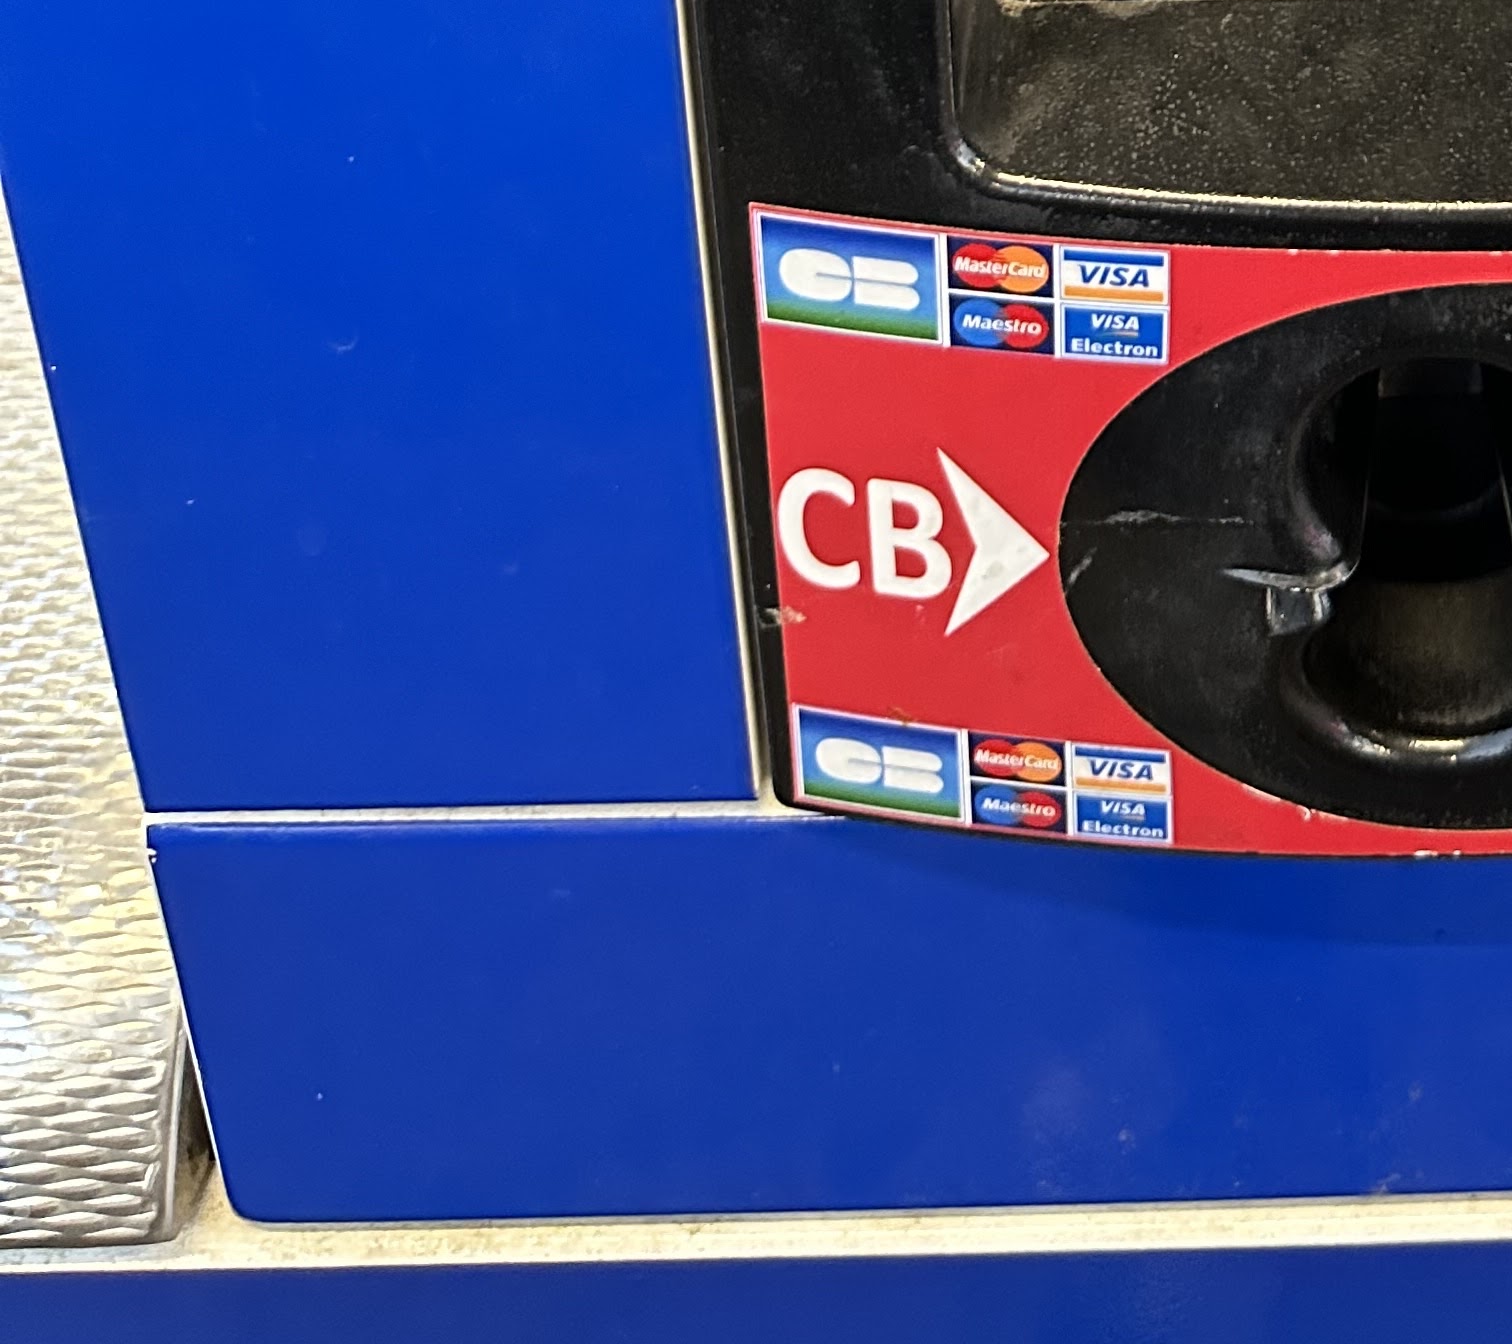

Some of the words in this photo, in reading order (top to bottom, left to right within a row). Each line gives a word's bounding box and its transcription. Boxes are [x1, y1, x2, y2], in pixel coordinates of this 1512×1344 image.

[954, 255, 1046, 280] MasterCard
[1077, 263, 1151, 288] VISA
[961, 312, 1043, 336] Maestro
[1089, 312, 1140, 331] VISA
[1070, 337, 1159, 359] Electron
[777, 467, 952, 599] CB
[974, 747, 1059, 771] MasterCard
[1088, 759, 1155, 782] VISA
[981, 796, 1057, 818] Maestro
[1100, 800, 1146, 816] VISA
[1081, 819, 1165, 840] Electron
